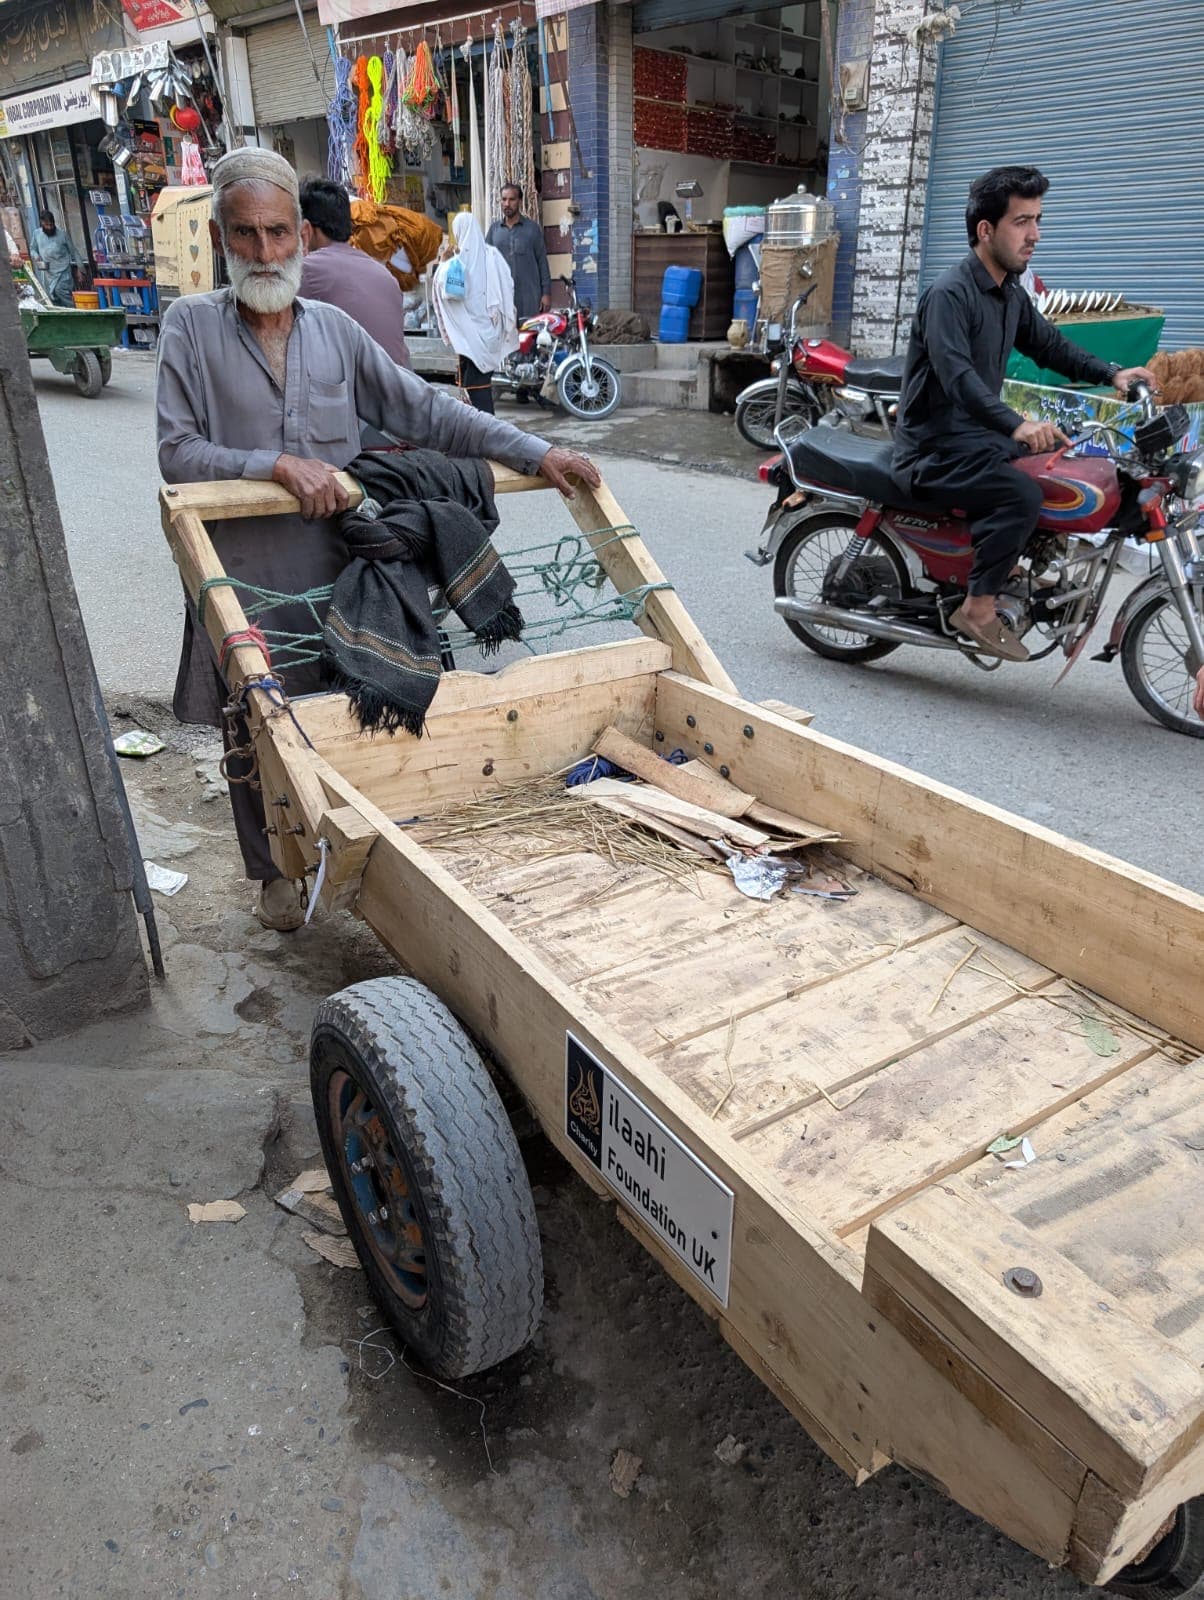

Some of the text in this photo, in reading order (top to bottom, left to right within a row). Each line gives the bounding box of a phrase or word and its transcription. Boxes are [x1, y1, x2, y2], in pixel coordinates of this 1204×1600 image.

[21, 92, 63, 119] CORPORATION
[569, 1120, 598, 1157] Charity
[608, 1093, 667, 1182] ilaahi
[607, 1146, 717, 1284] Foundation UK
